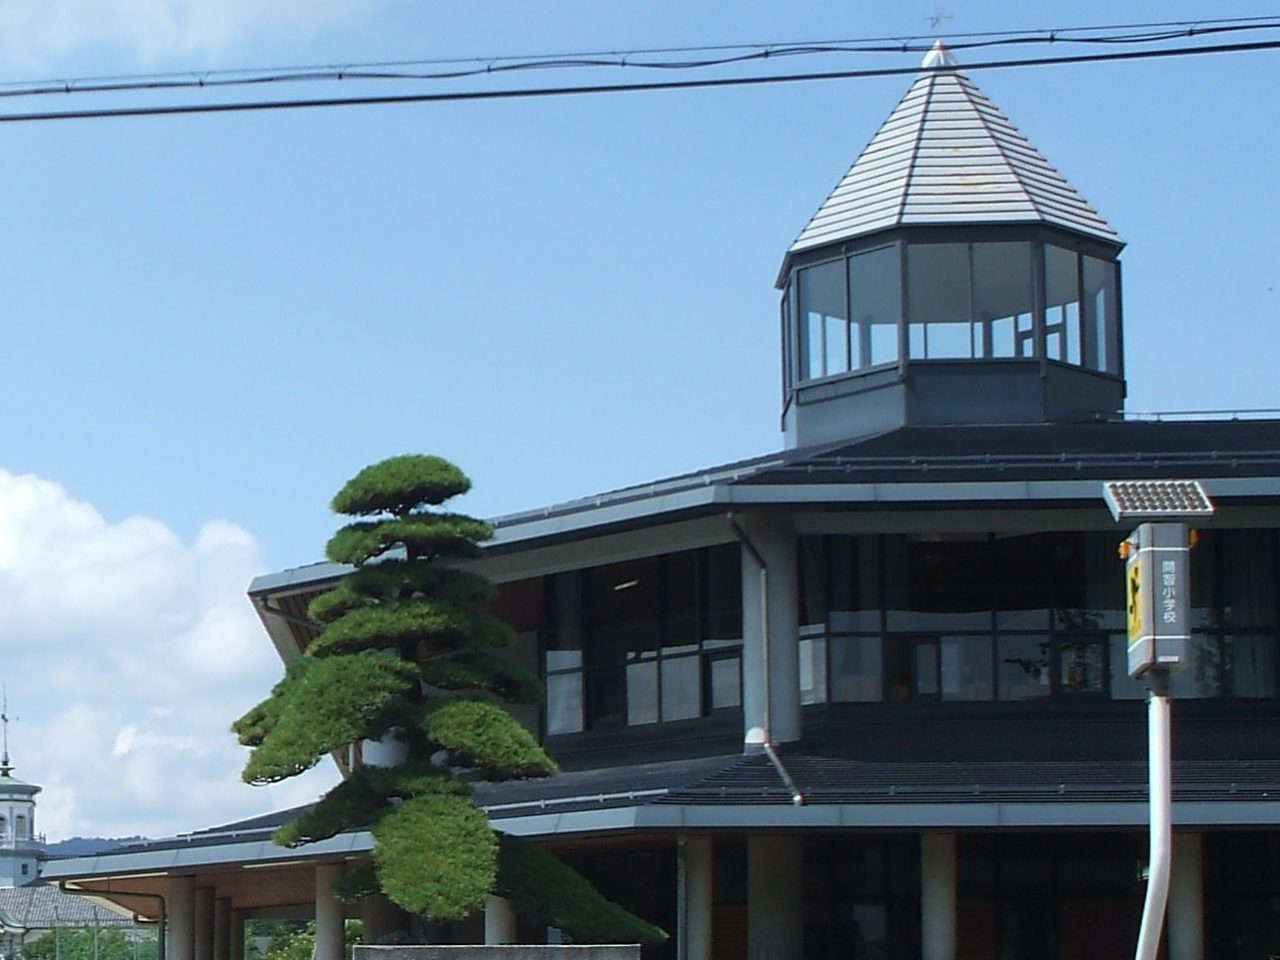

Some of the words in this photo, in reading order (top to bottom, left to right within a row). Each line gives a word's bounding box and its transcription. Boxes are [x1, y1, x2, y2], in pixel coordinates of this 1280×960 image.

[1162, 560, 1176, 624] 開智小学校
